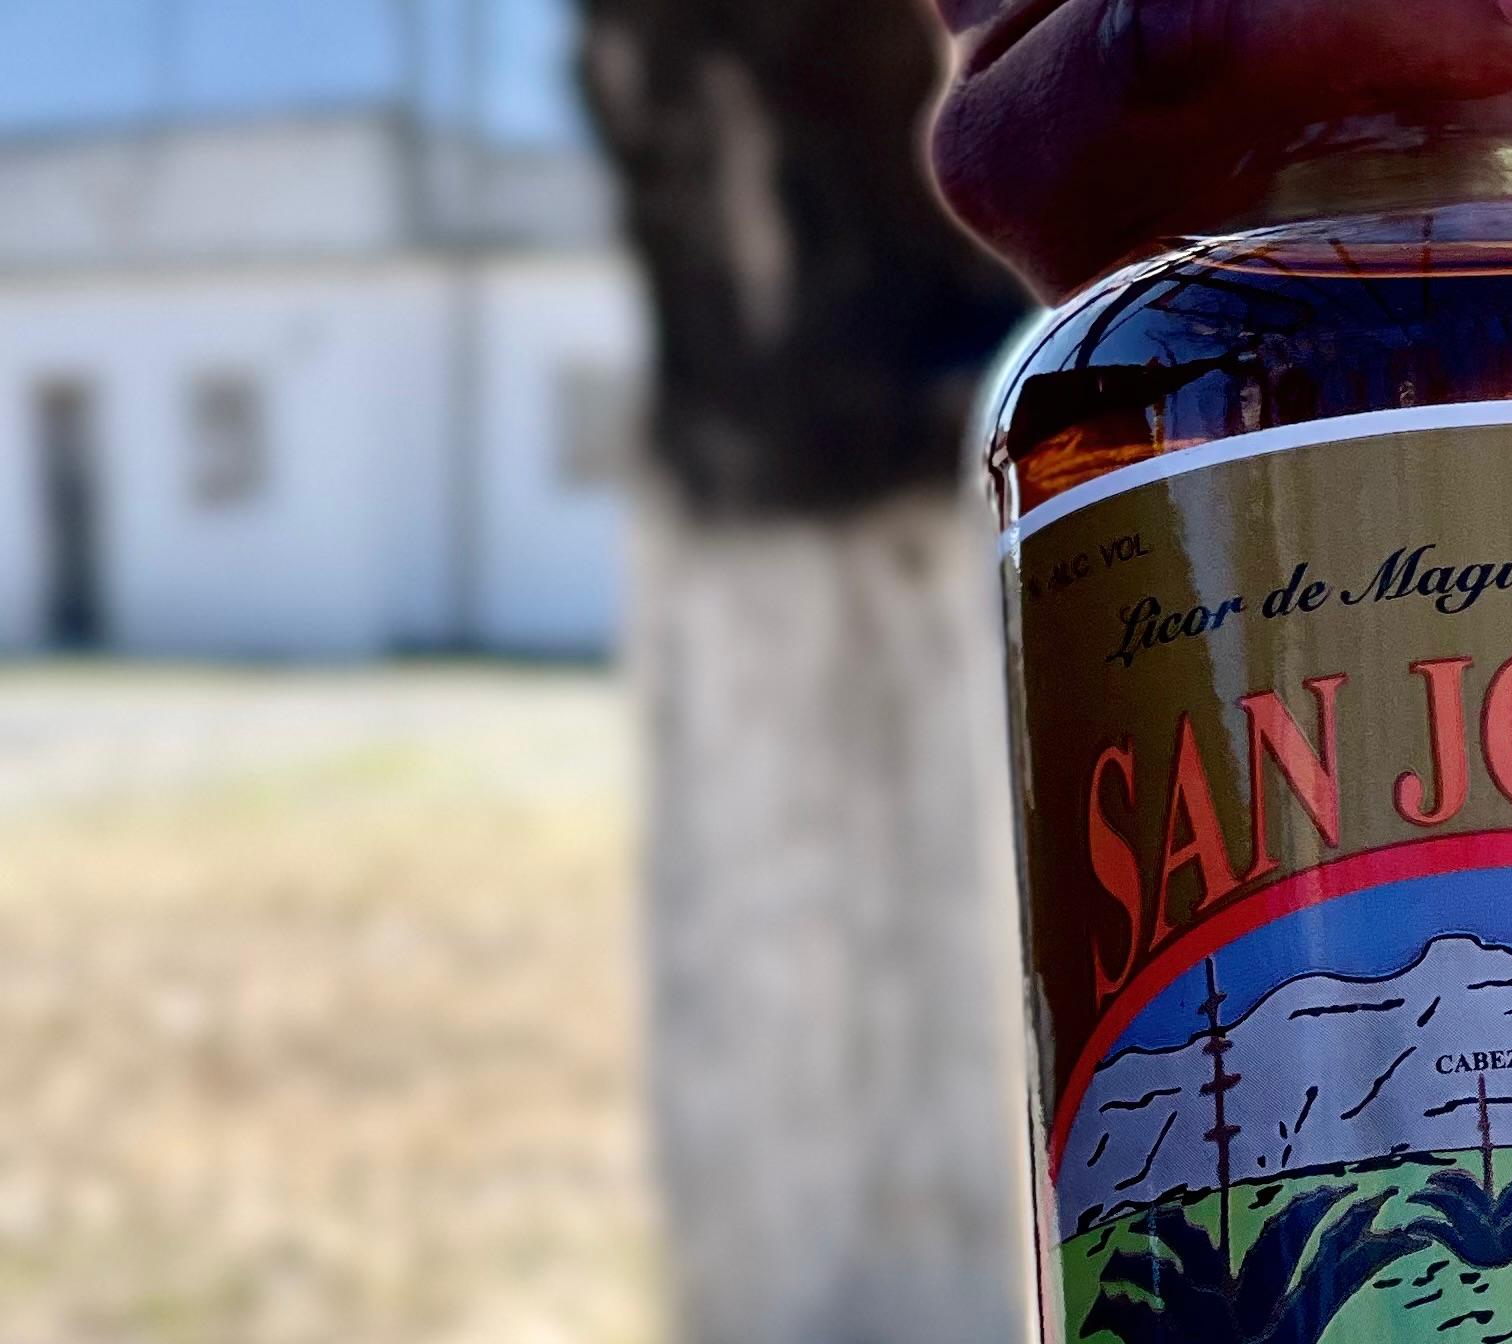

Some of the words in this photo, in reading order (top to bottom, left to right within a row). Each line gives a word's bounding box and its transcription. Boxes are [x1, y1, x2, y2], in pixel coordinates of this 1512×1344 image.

[1104, 595, 1247, 668] Licor
[1262, 563, 1333, 619] de
[1086, 672, 1347, 1010] SAN
